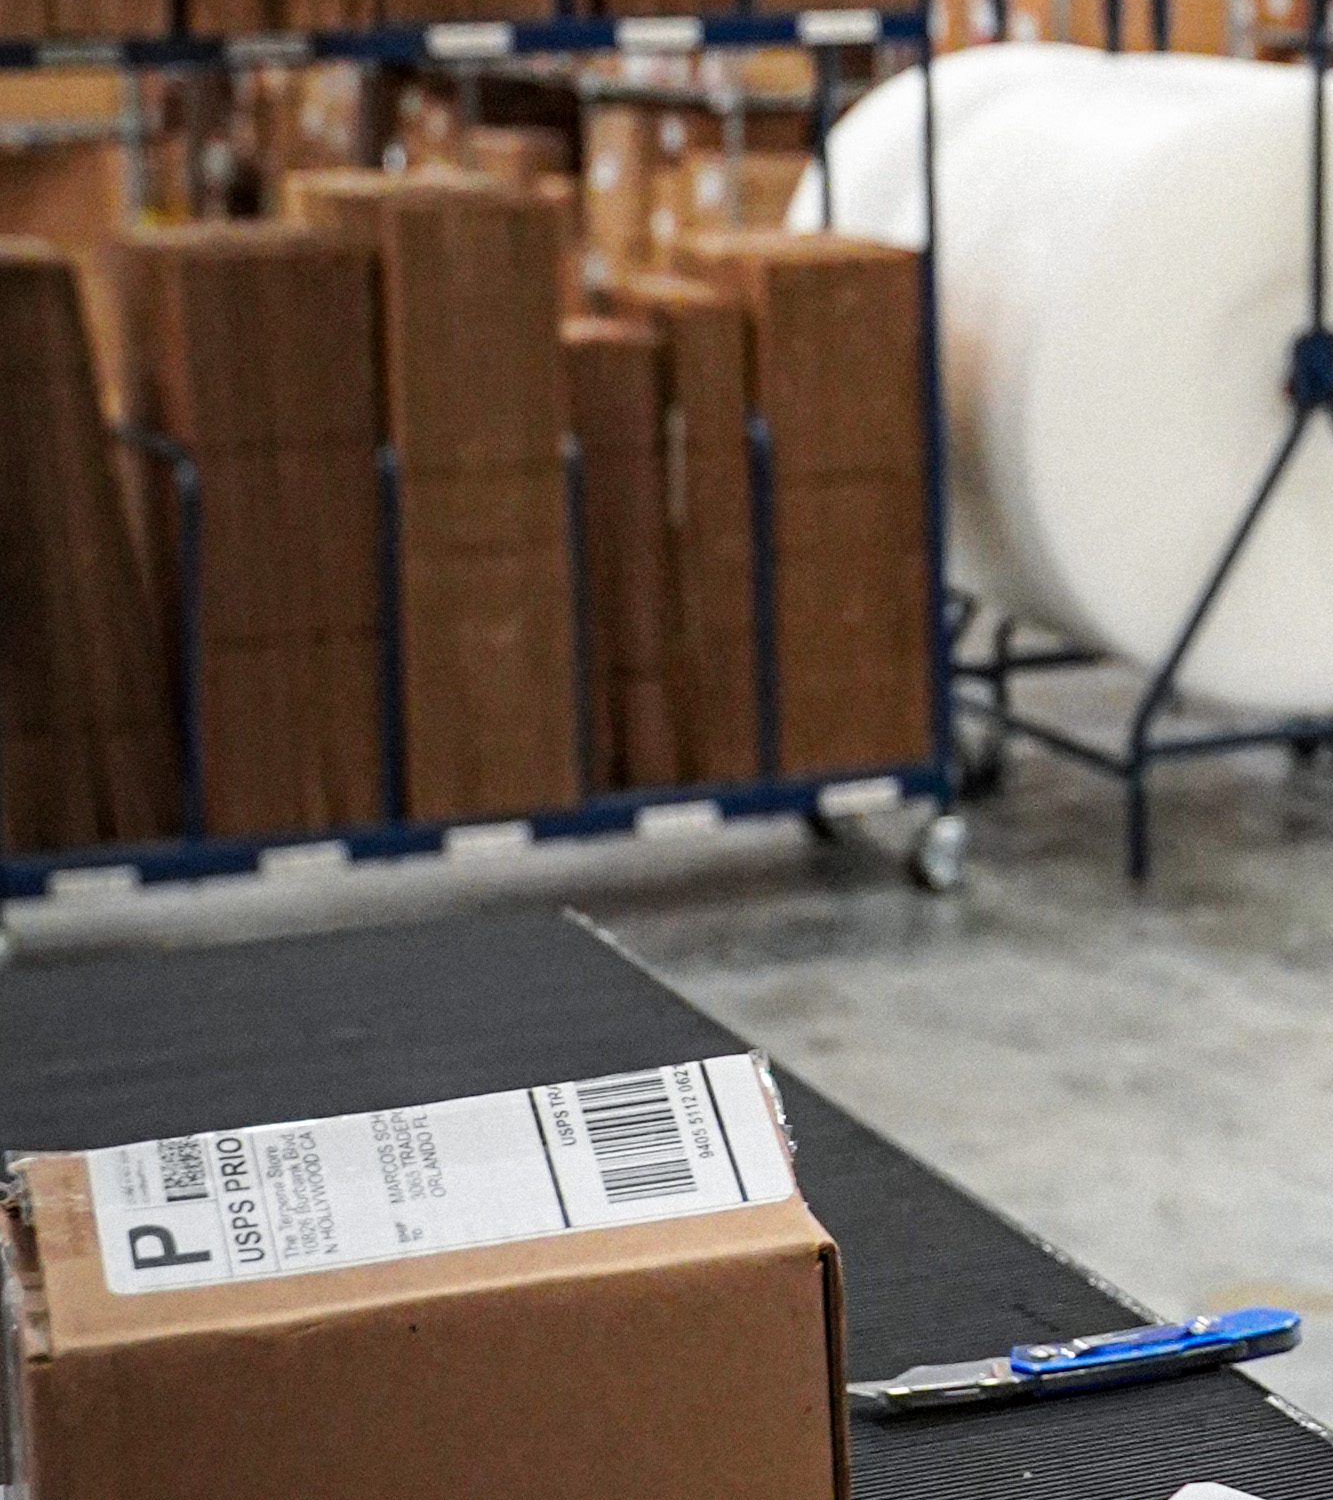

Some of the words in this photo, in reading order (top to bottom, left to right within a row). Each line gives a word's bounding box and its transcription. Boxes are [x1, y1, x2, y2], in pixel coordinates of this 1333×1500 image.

[413, 1113, 430, 1129] FL
[681, 1095, 704, 1125] 5112
[299, 1131, 316, 1150] CA
[554, 1110, 577, 1147] USPS
[692, 1128, 715, 1159] 9405
[266, 1145, 283, 1178] Store
[280, 1133, 299, 1160] Blvd
[216, 1137, 250, 1192] PRIO
[377, 1144, 405, 1204] MARCOS
[416, 1131, 447, 1198] ORLANDO
[302, 1153, 333, 1239] HOLLYWOOD
[128, 1223, 212, 1270] P
[228, 1199, 265, 1263] USPS
[284, 1235, 300, 1259] The
[412, 1228, 423, 1241] TO
[325, 1243, 338, 1255] N
